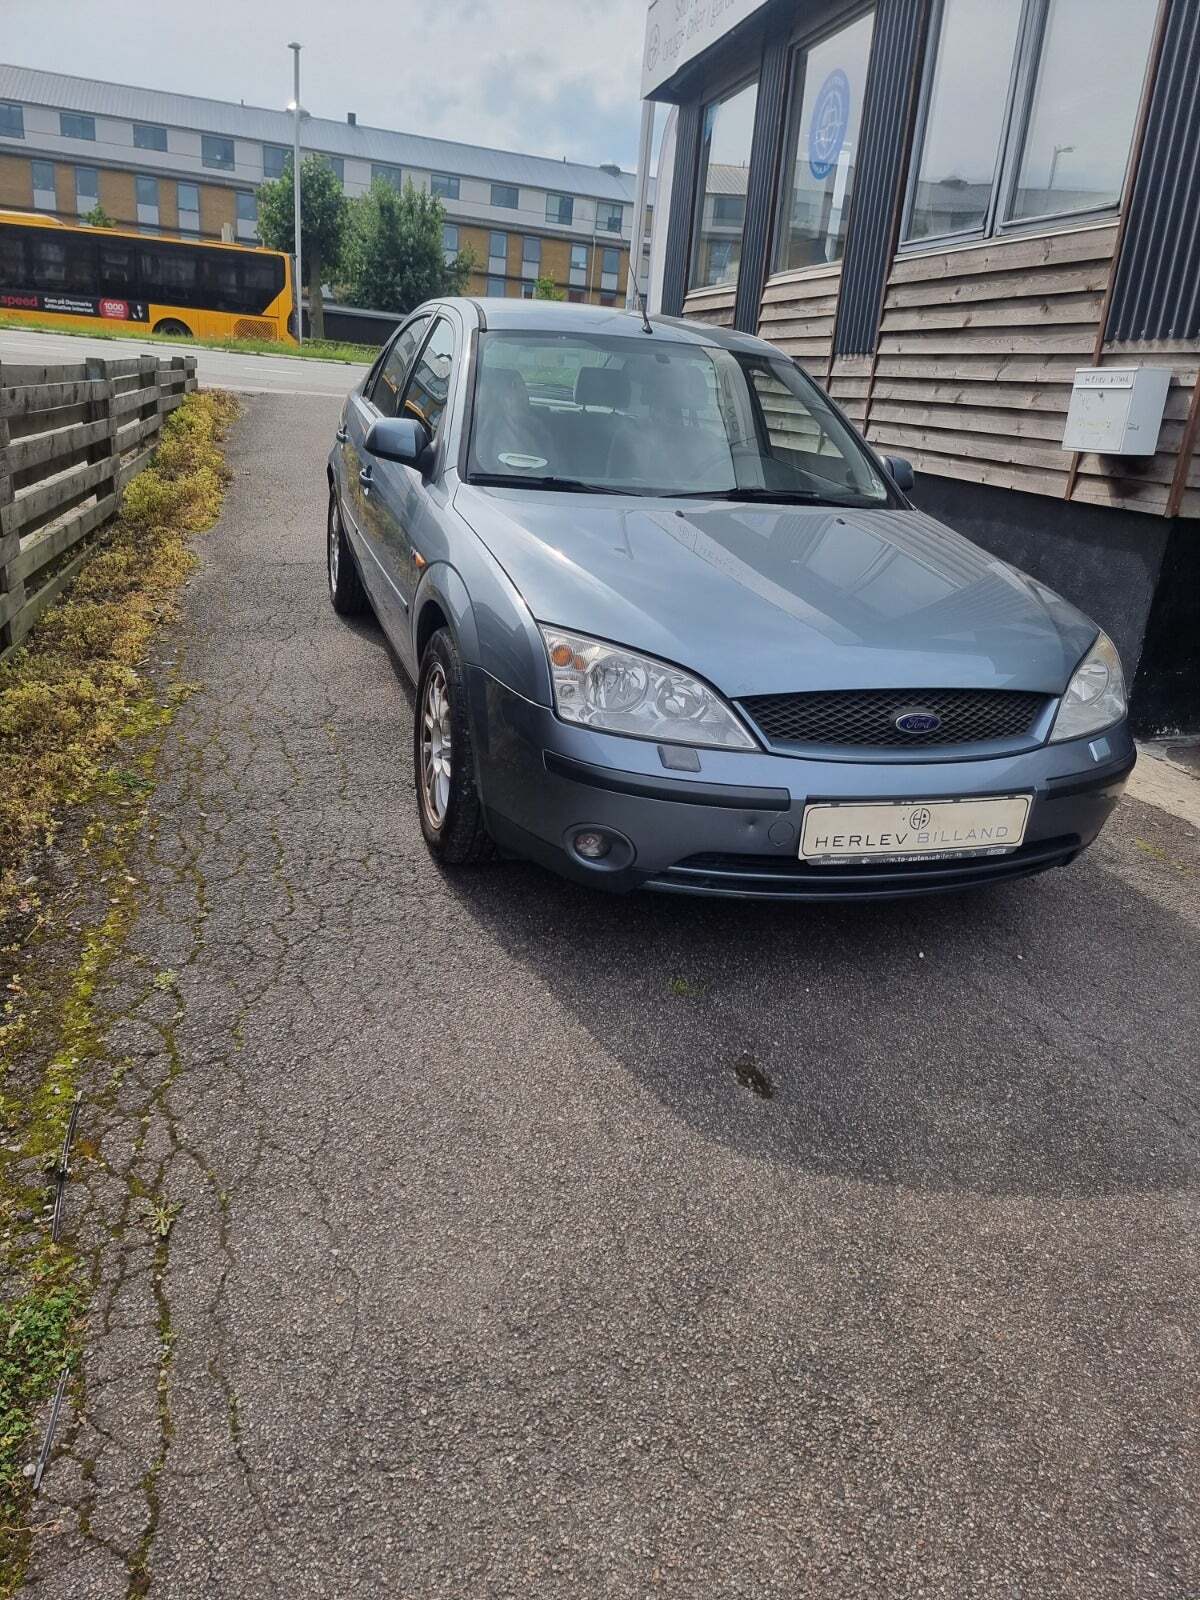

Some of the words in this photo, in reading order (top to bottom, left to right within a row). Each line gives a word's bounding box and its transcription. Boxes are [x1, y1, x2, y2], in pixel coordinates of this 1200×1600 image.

[104, 302, 124, 311] 1000
[815, 833, 908, 848] HERLEV
[917, 826, 1009, 844] BILLAND
